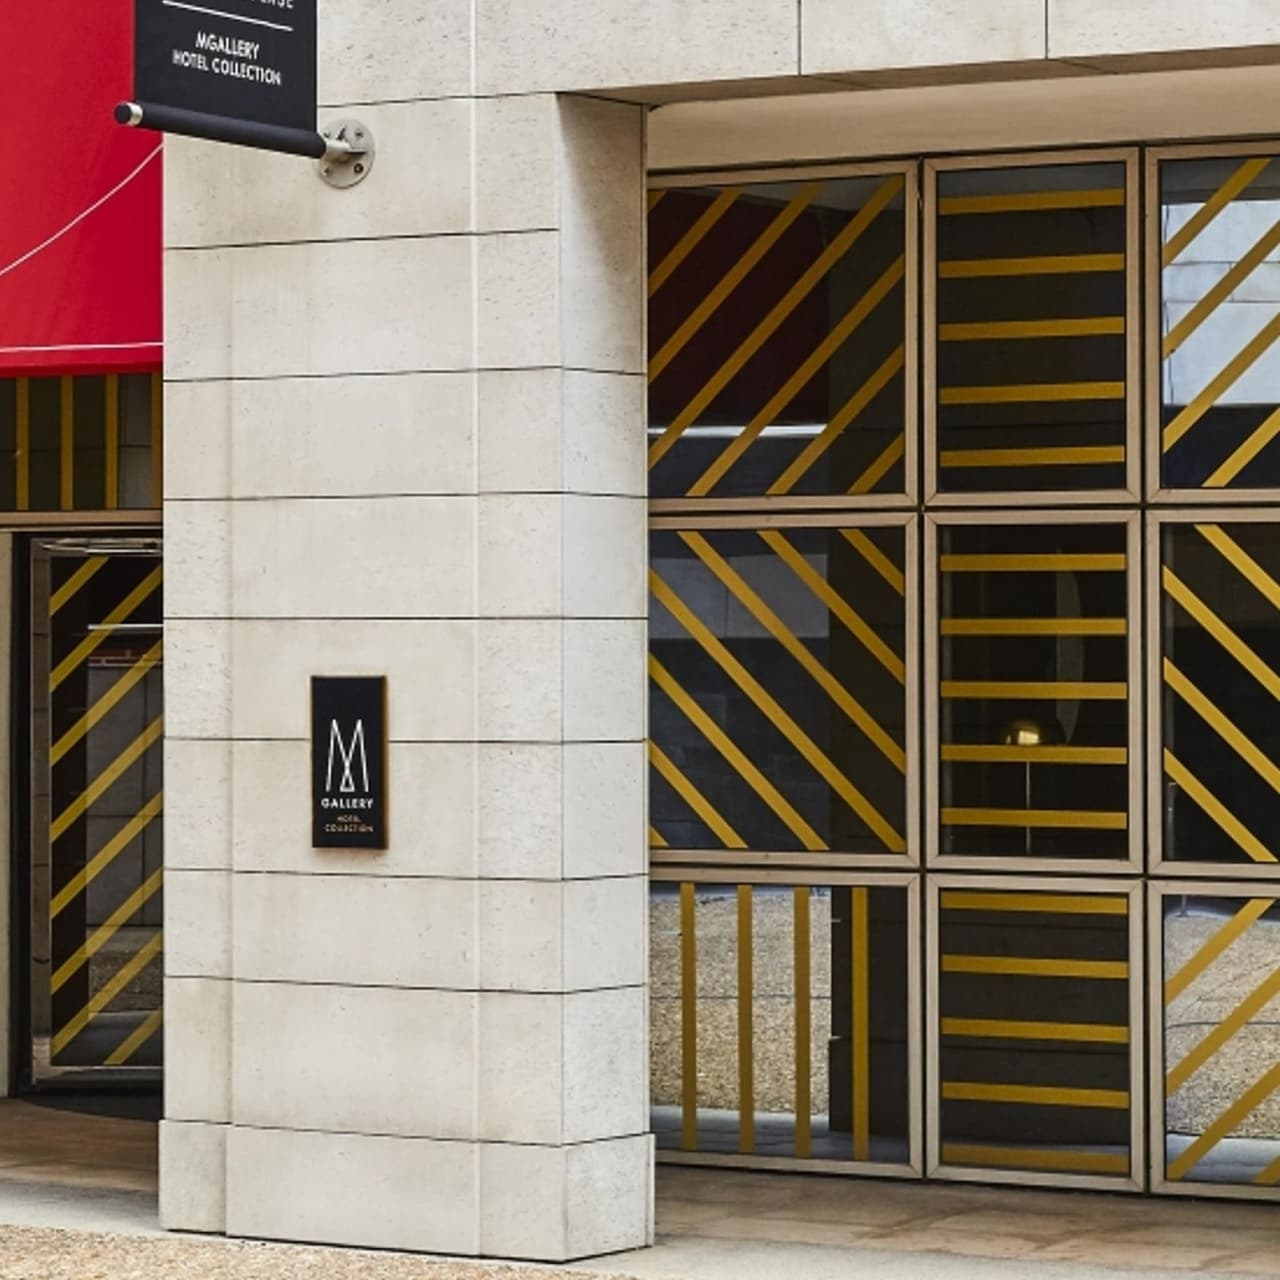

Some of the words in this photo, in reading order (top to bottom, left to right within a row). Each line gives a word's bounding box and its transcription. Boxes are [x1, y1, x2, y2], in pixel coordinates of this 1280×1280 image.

[195, 31, 260, 60] MGALLERY
[172, 49, 210, 71] HOTEL
[211, 58, 282, 86] COLLECTION
[321, 797, 374, 809] GALLERY
